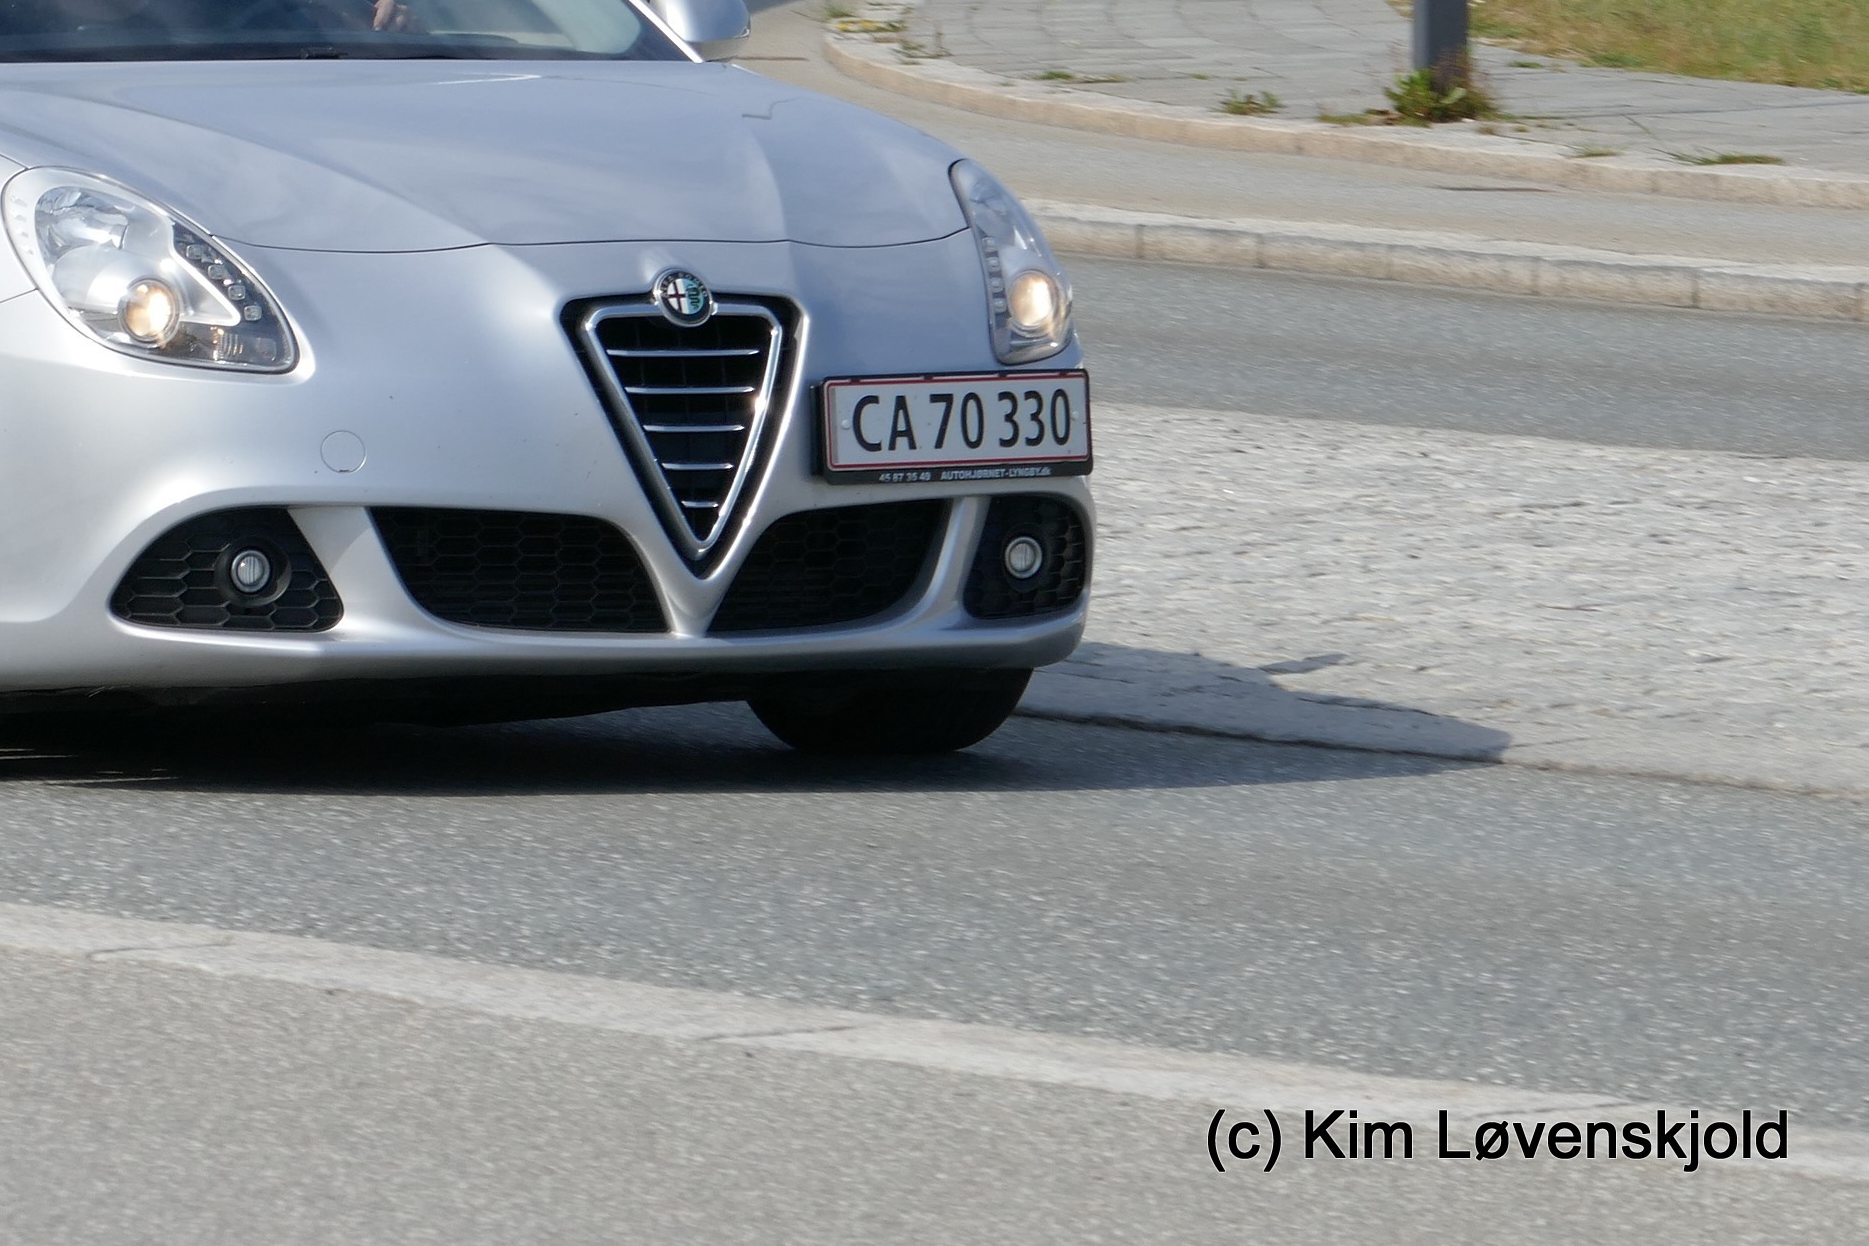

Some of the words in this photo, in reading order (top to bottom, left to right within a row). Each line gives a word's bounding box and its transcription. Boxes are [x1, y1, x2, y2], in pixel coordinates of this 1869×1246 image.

[852, 394, 917, 452] CA
[929, 391, 984, 450] 70
[997, 388, 1071, 448] 330
